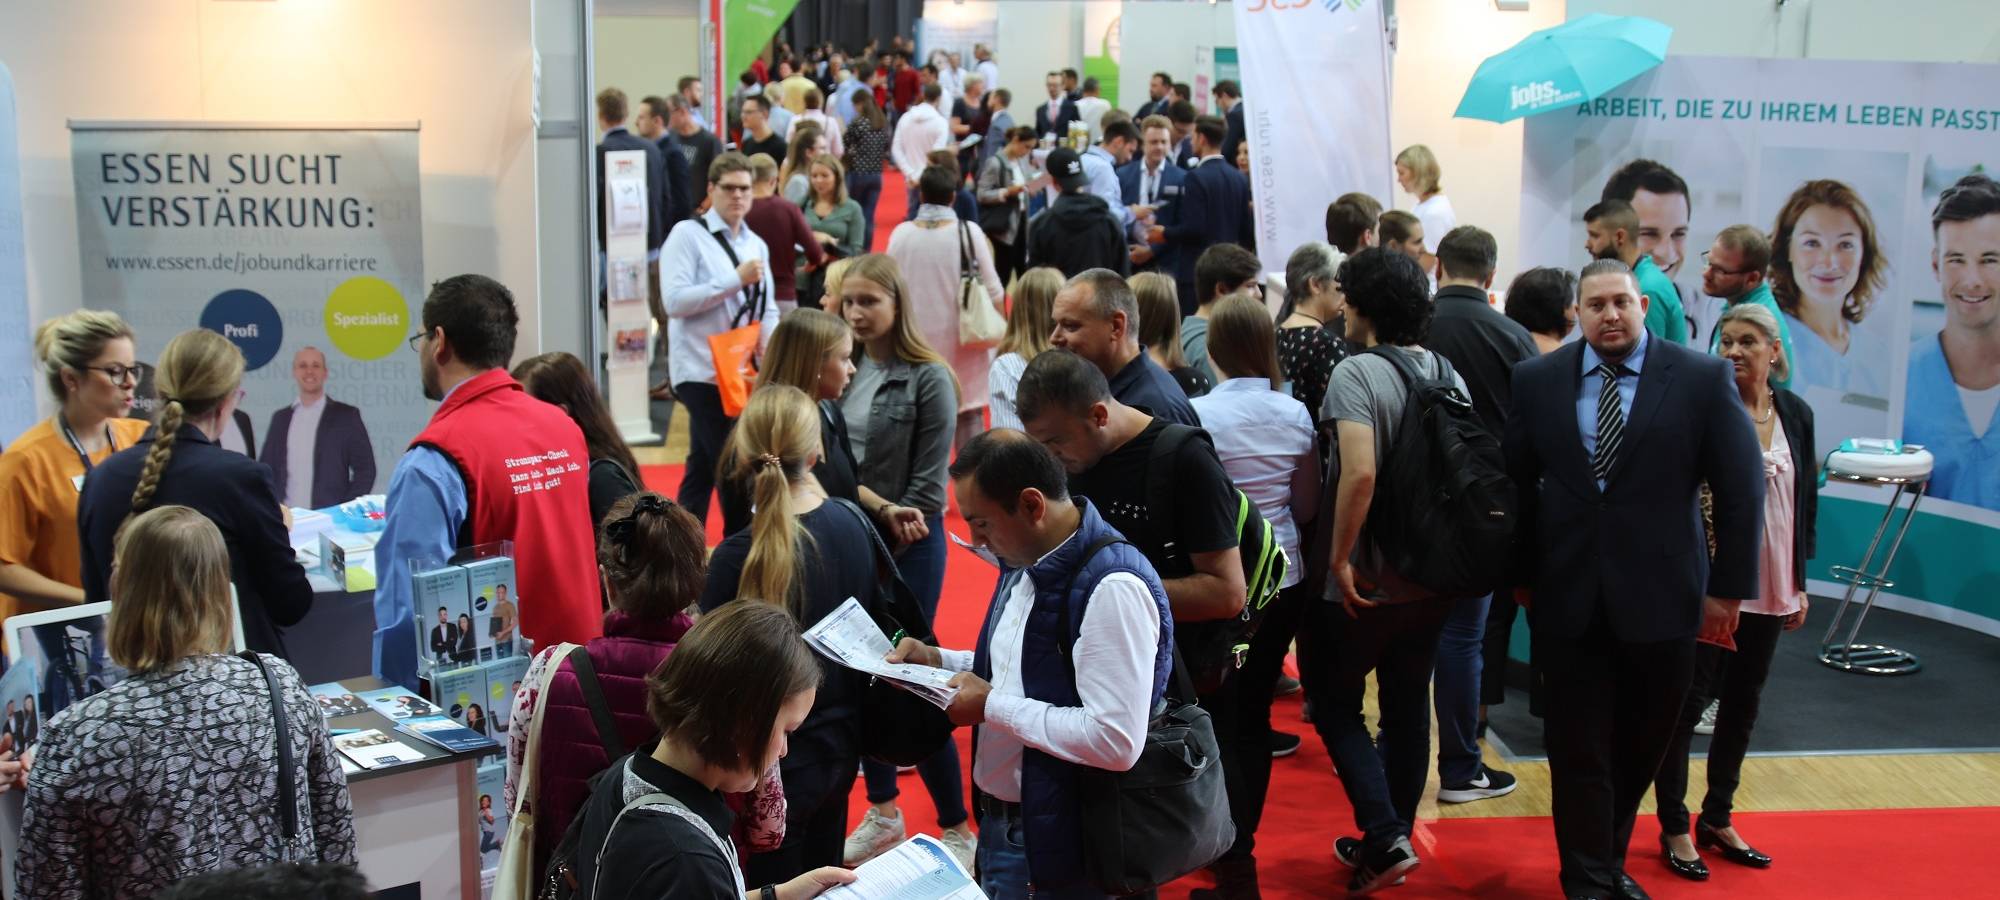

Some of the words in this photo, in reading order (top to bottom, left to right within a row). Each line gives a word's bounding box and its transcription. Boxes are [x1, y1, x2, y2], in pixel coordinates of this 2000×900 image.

[1511, 80, 1561, 110] jobs.
[1577, 98, 1666, 120] ARBEIT,
[1676, 99, 1713, 118] DIE
[1722, 100, 1752, 119] ZU
[1761, 102, 1837, 123] IHREM
[1846, 104, 1923, 127] LEBEN
[1931, 107, 2000, 132] PASST
[101, 153, 211, 185] ESSEN
[228, 154, 342, 186] SUCHT
[101, 188, 375, 229] VERSTÄRKUNG:
[105, 251, 378, 274] www.essen.de/jobundkarriere
[224, 323, 259, 338] Profi
[333, 311, 400, 328] Spezialist
[509, 473, 529, 483] Kann
[545, 478, 560, 490] gut!
